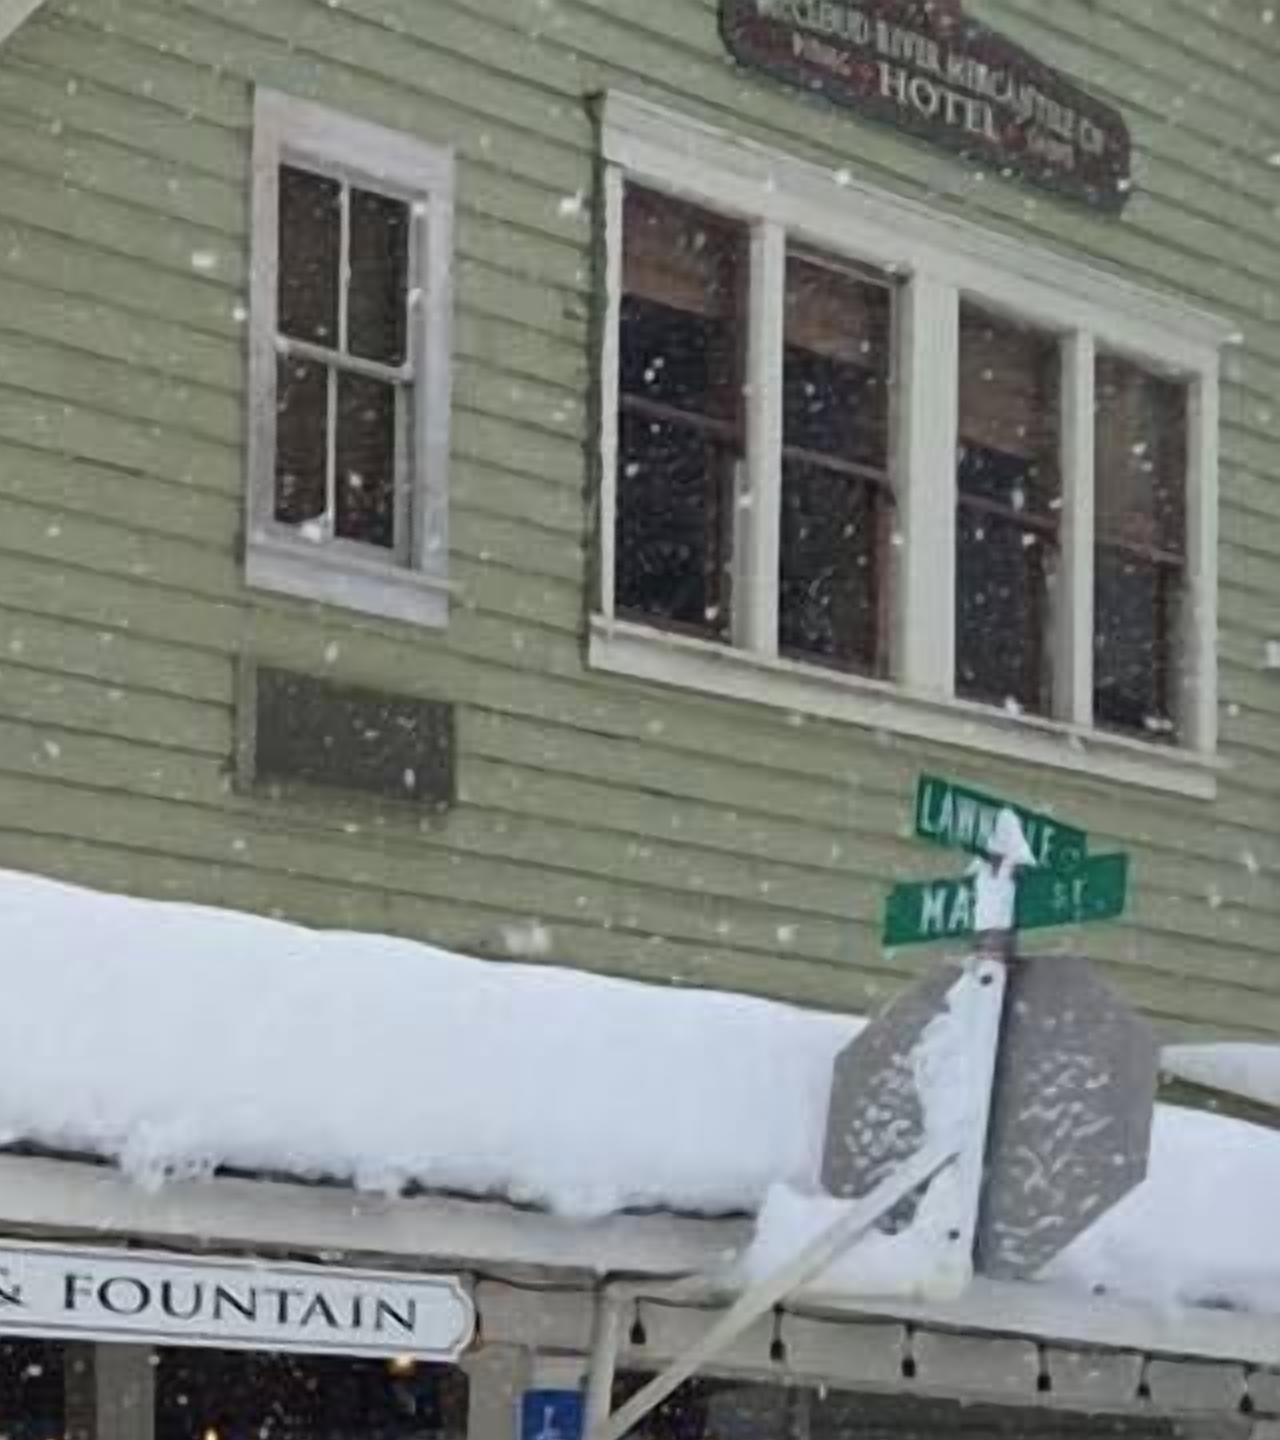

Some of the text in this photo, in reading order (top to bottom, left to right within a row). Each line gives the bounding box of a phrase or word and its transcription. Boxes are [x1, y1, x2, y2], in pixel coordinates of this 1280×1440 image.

[880, 60, 1002, 143] HOTEL
[918, 884, 975, 934] MA
[62, 1272, 420, 1335] FOUNTAIN
